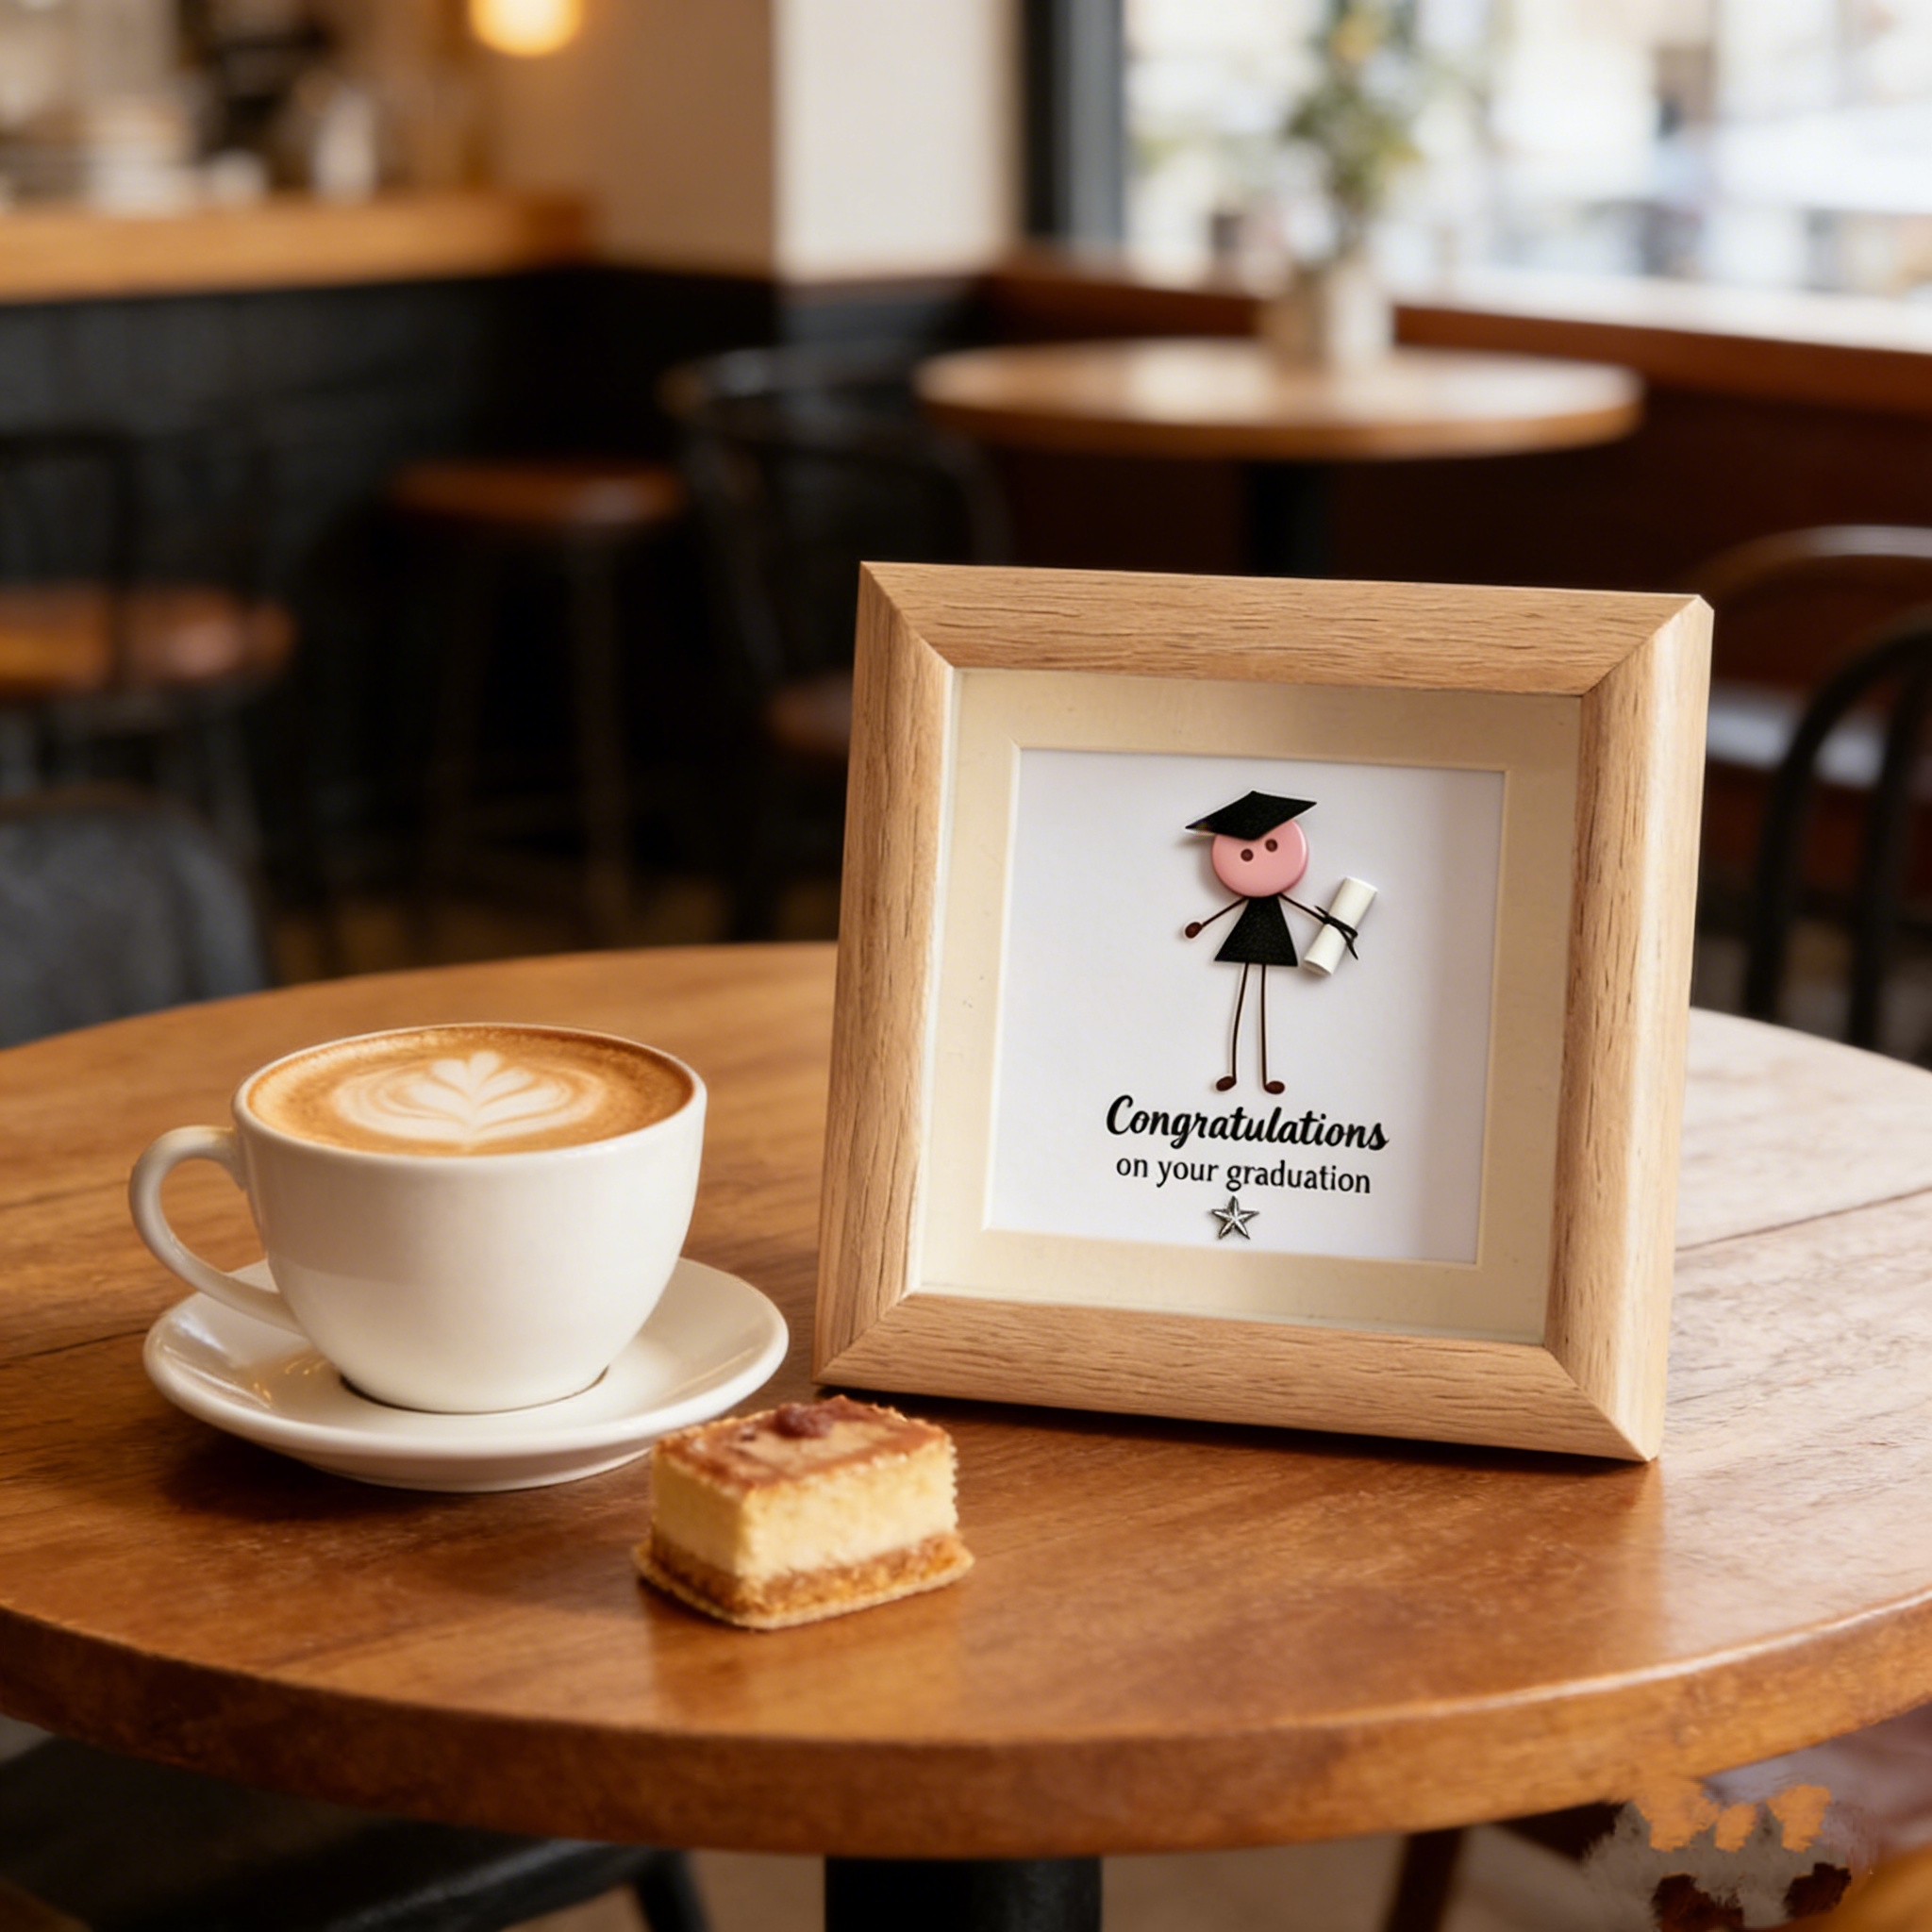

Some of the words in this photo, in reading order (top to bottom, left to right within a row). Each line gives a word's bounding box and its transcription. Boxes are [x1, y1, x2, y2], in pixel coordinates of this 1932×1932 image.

[1106, 1094, 1390, 1151] Congratulations
[1116, 1158, 1148, 1178] on
[1156, 1160, 1219, 1189] your
[1225, 1159, 1371, 1194] graduation
